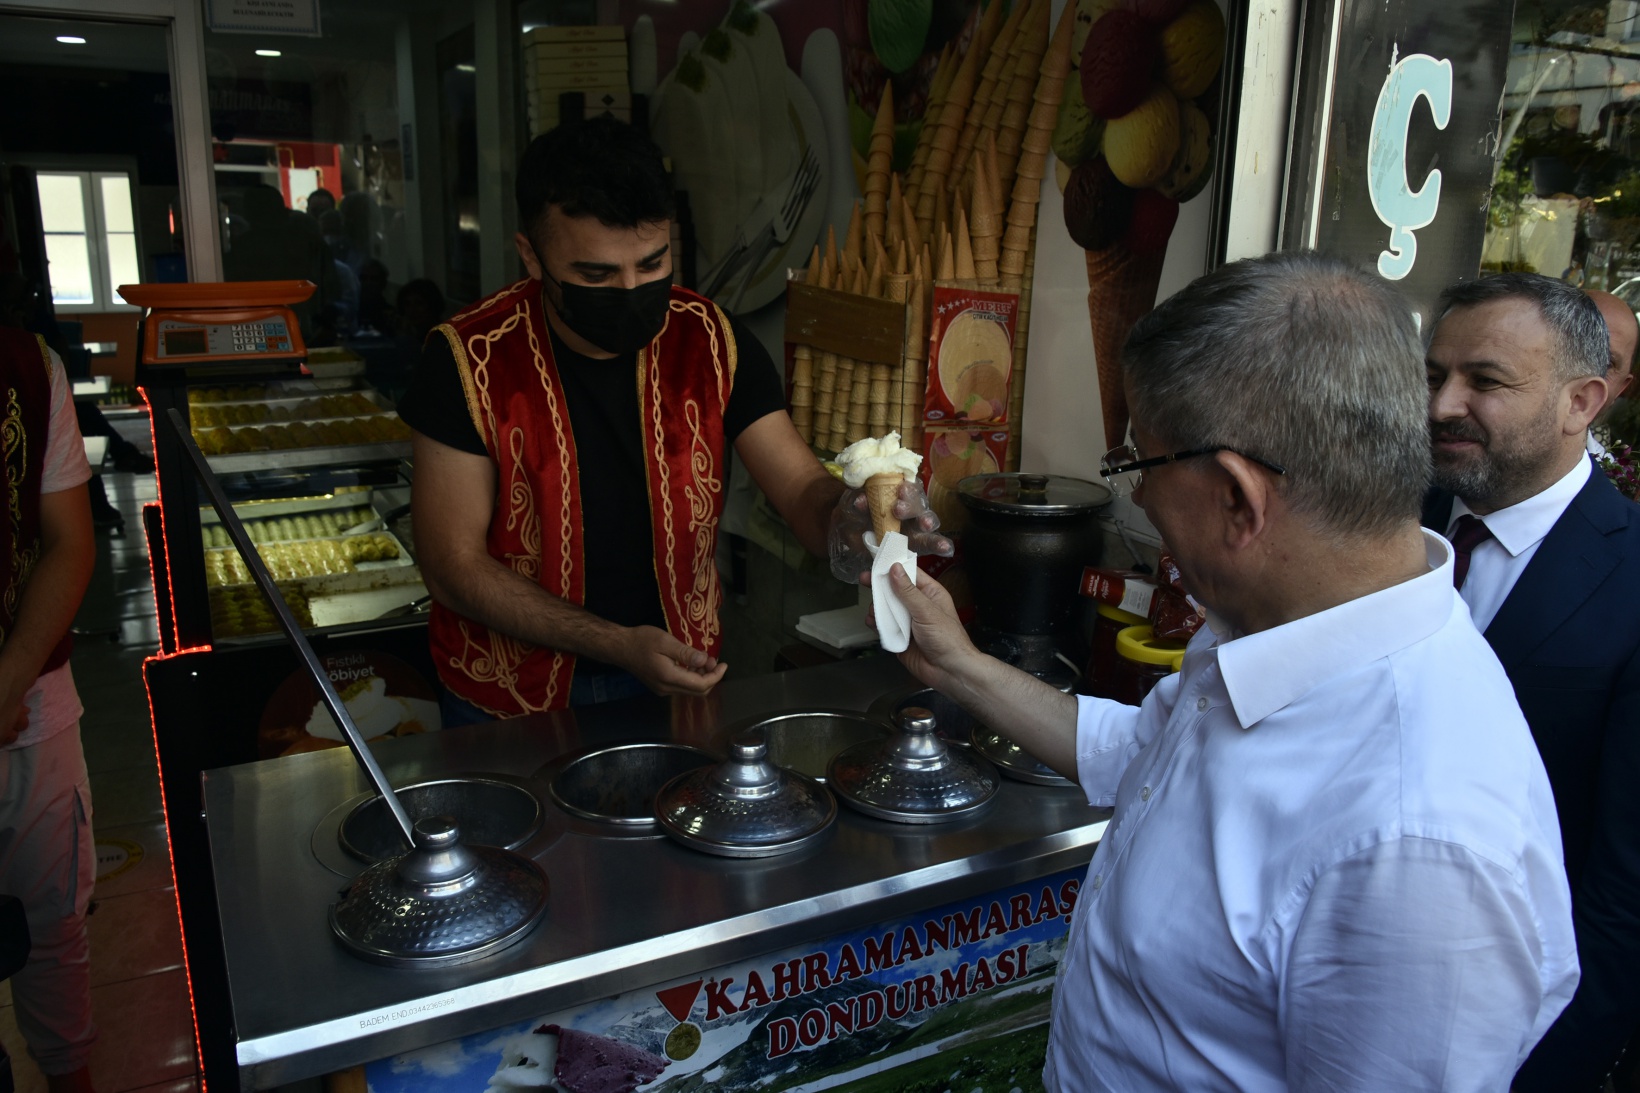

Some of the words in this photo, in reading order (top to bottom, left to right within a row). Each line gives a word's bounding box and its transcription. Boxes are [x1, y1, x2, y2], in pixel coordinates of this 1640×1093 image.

[972, 300, 1012, 314] MERT
[327, 664, 375, 682] öbiyet
[704, 878, 1081, 1021] KAHRAMANMARAŞ
[767, 944, 1029, 1059] DONDURMASI
[359, 1014, 389, 1029] BADEM
